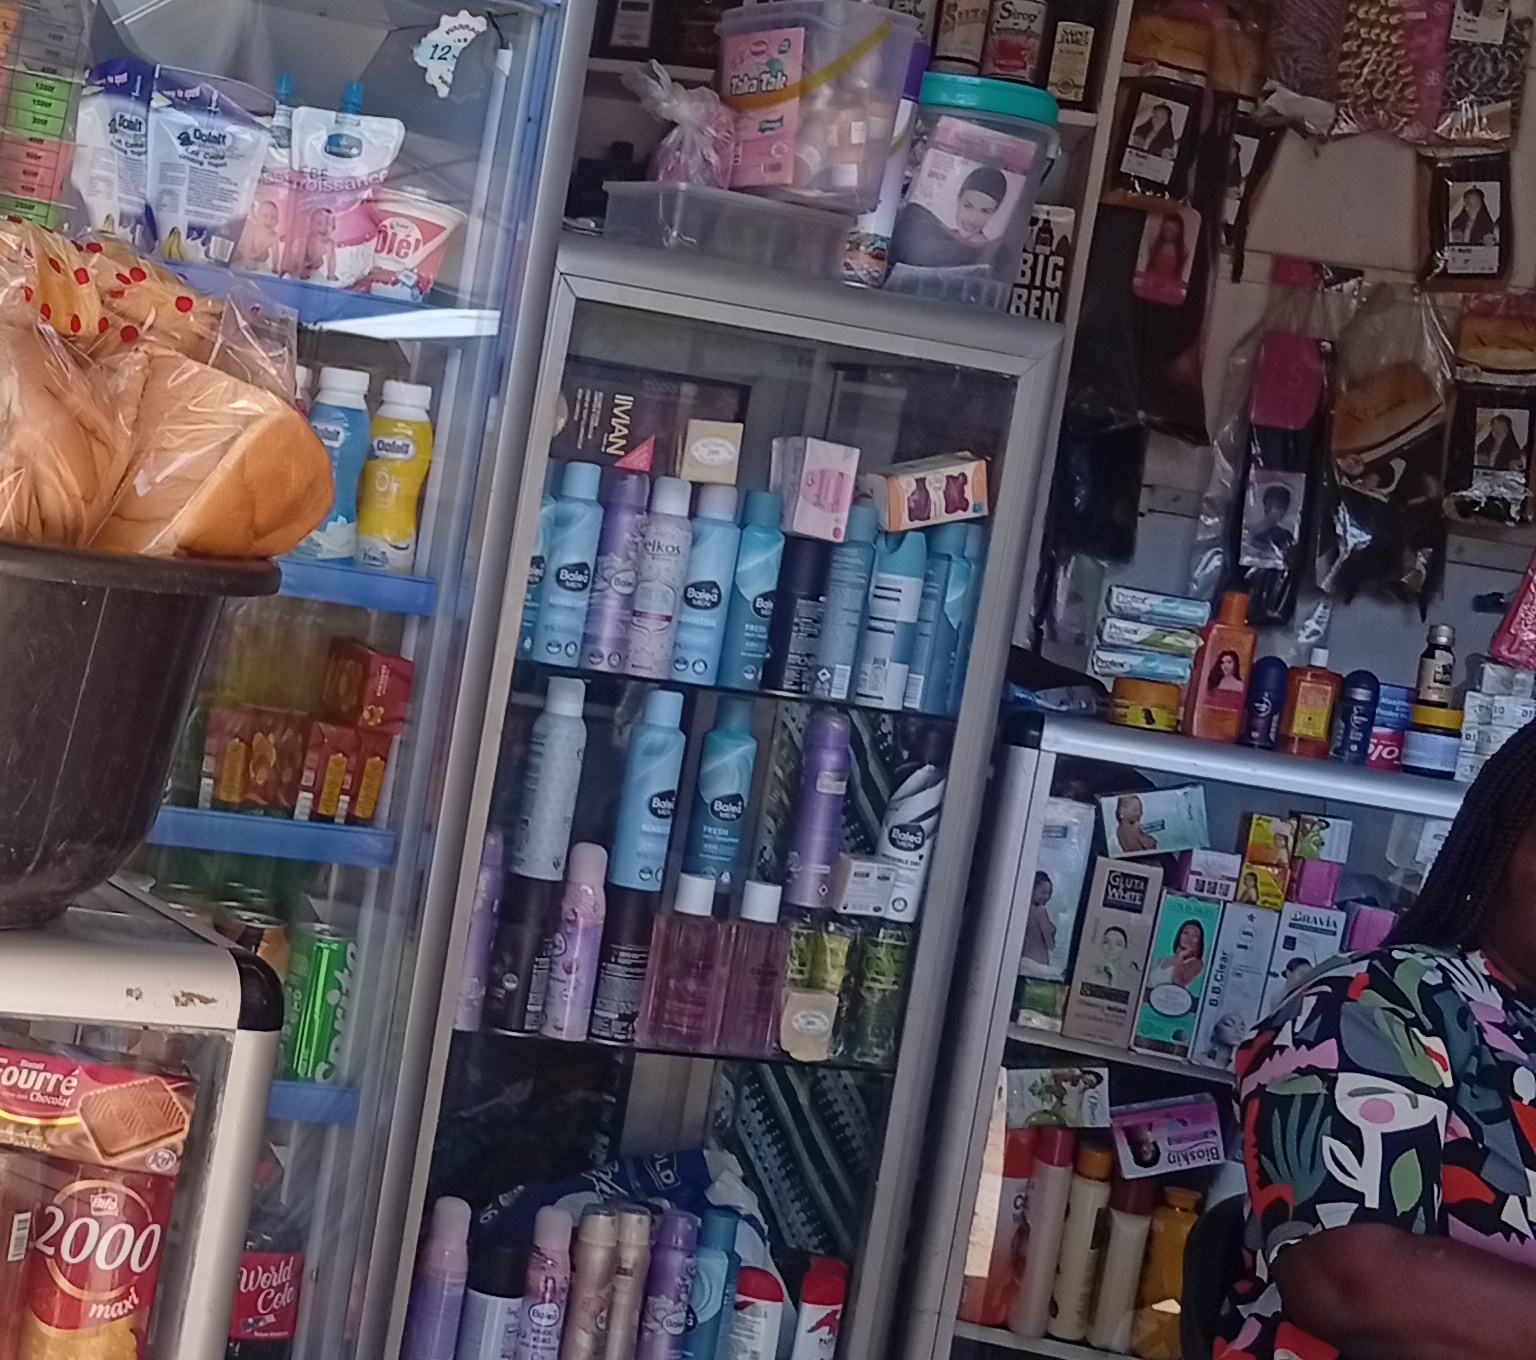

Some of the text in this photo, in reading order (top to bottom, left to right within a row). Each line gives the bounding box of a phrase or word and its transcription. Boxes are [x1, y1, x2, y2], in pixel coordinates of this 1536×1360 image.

[429, 43, 452, 61] 12
[1019, 252, 1065, 290] BIG
[1010, 287, 1060, 323] BEN
[559, 568, 589, 583] Balea
[686, 588, 719, 602] Balea
[714, 800, 743, 814] Balea
[891, 829, 923, 845] Balea
[1109, 872, 1145, 890] GLUTA
[1107, 886, 1143, 904] WHITE
[29, 1092, 71, 1108] Chocolat
[1167, 1145, 1220, 1167] Bioskin
[35, 1205, 162, 1274] 2000
[240, 1256, 294, 1293] World
[89, 1286, 140, 1320] maxi
